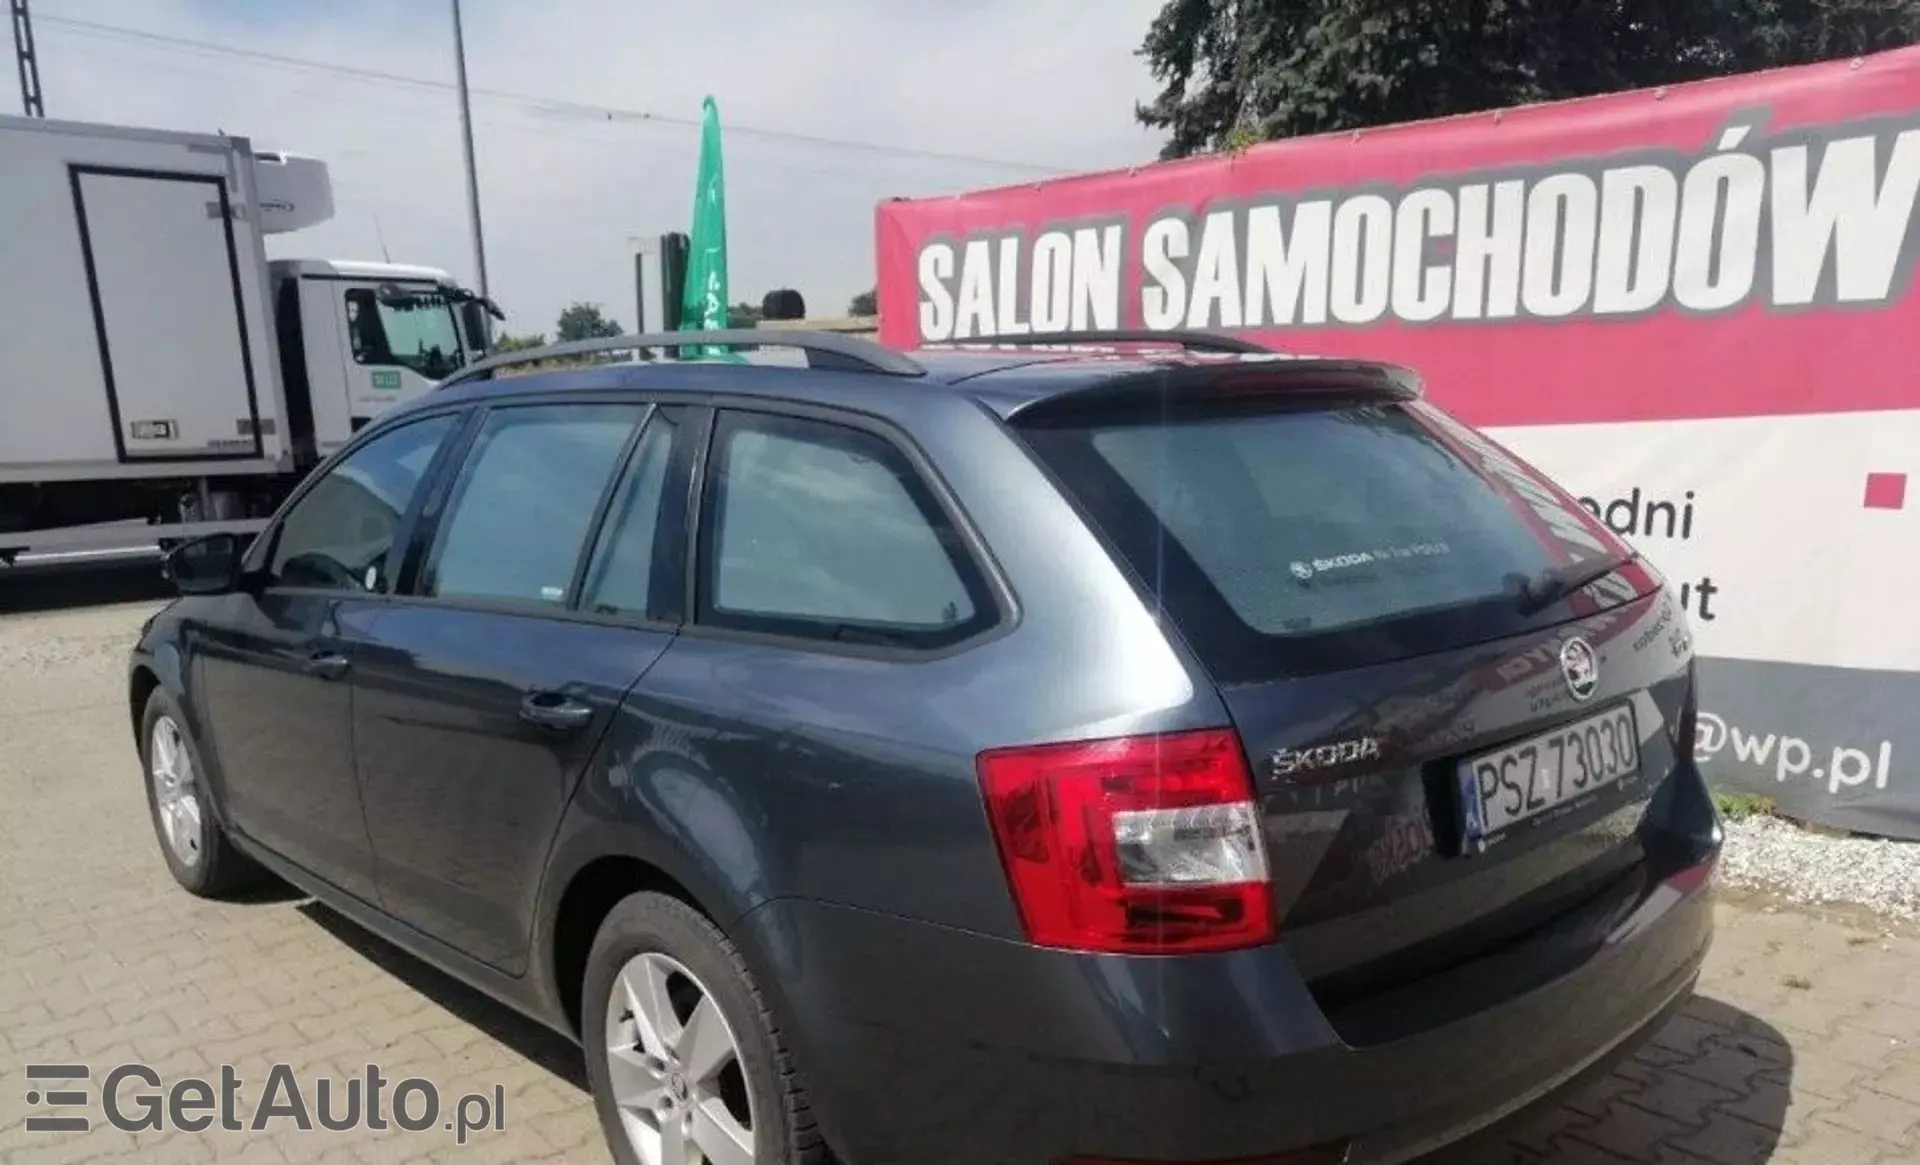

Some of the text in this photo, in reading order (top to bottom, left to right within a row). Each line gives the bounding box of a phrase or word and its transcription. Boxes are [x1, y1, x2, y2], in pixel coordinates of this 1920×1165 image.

[918, 126, 1920, 341] SALON SAMOCHODÓW
[1477, 713, 1634, 828] PSZ 73030
[1693, 711, 1892, 794] @wp.pl
